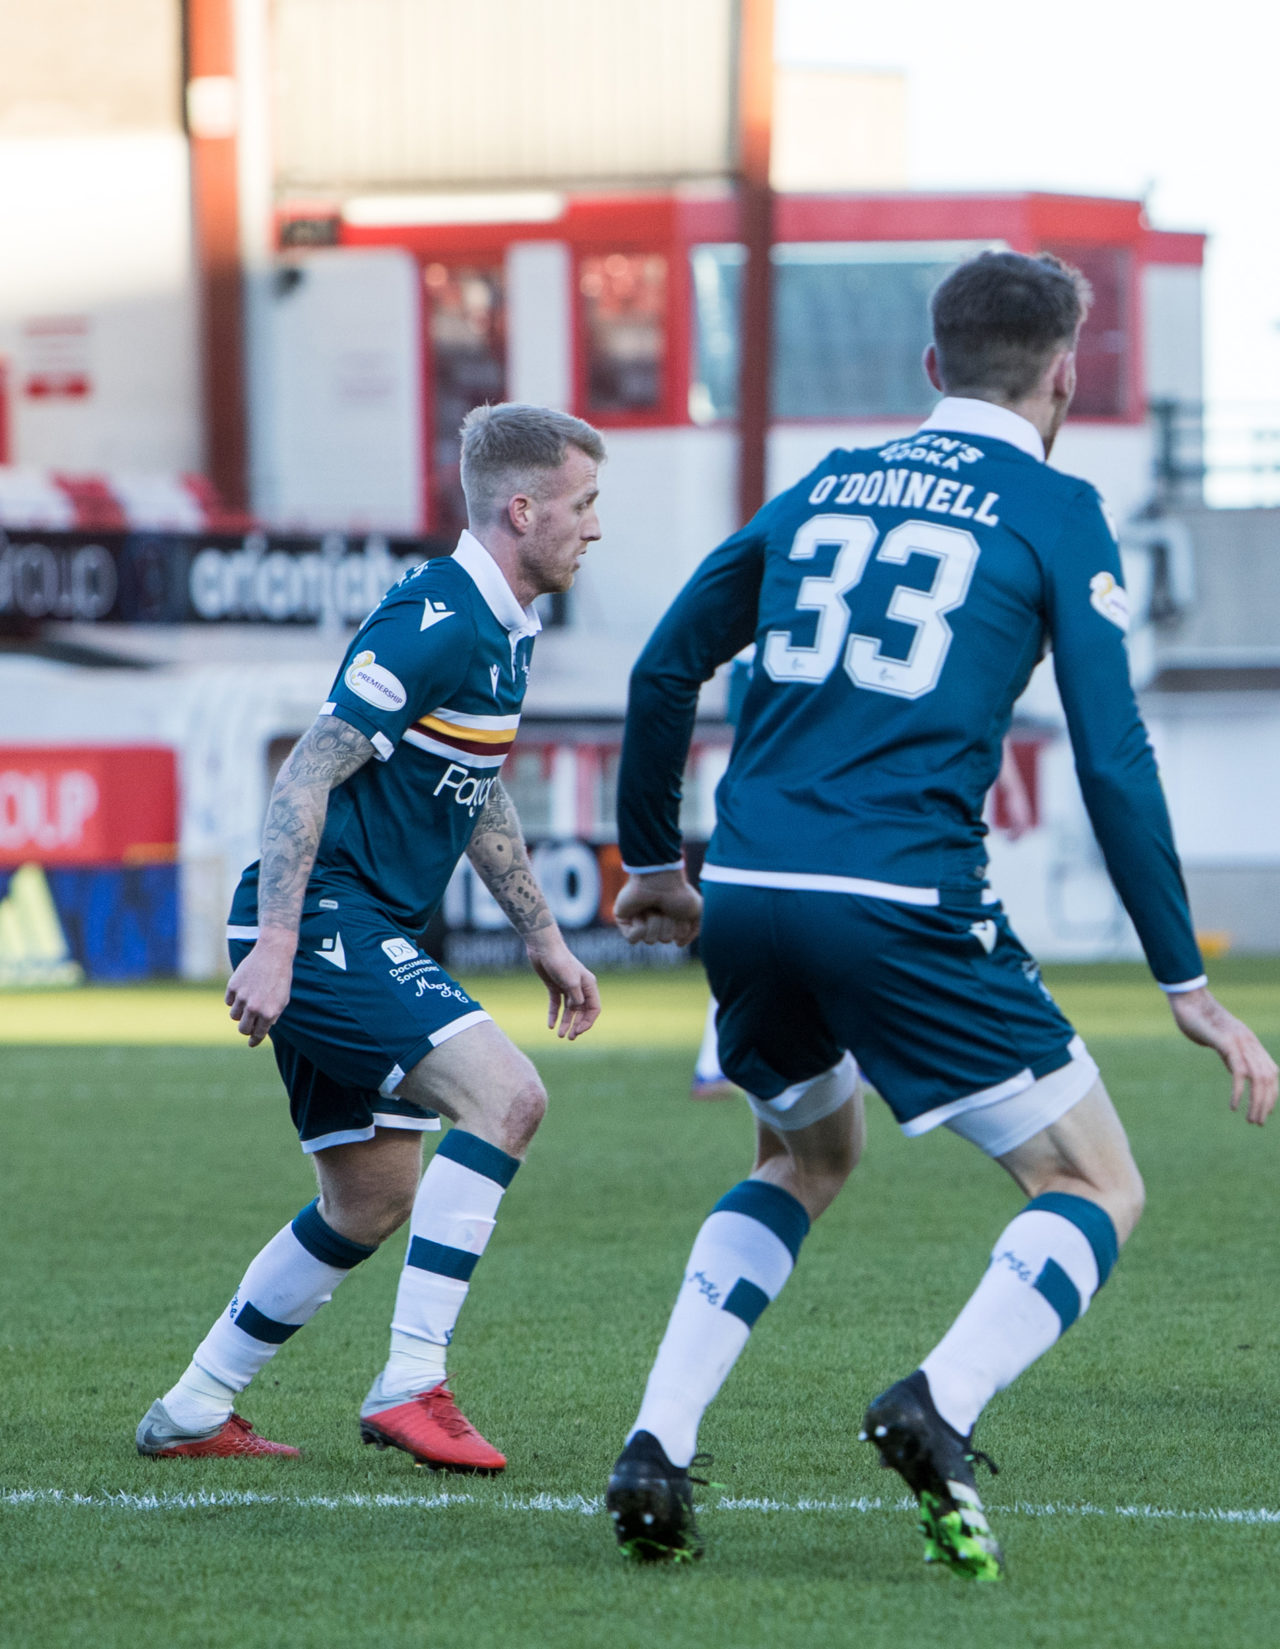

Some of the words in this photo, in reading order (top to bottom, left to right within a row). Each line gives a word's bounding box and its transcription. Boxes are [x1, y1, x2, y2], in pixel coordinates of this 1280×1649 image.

[808, 468, 1000, 528] O'DONNELL
[762, 513, 981, 700] 33
[357, 671, 404, 705] PREMIERSHIP
[386, 943, 414, 958] DS
[389, 959, 433, 978] DOCUMENT
[396, 966, 440, 985] SOLUTIONS
